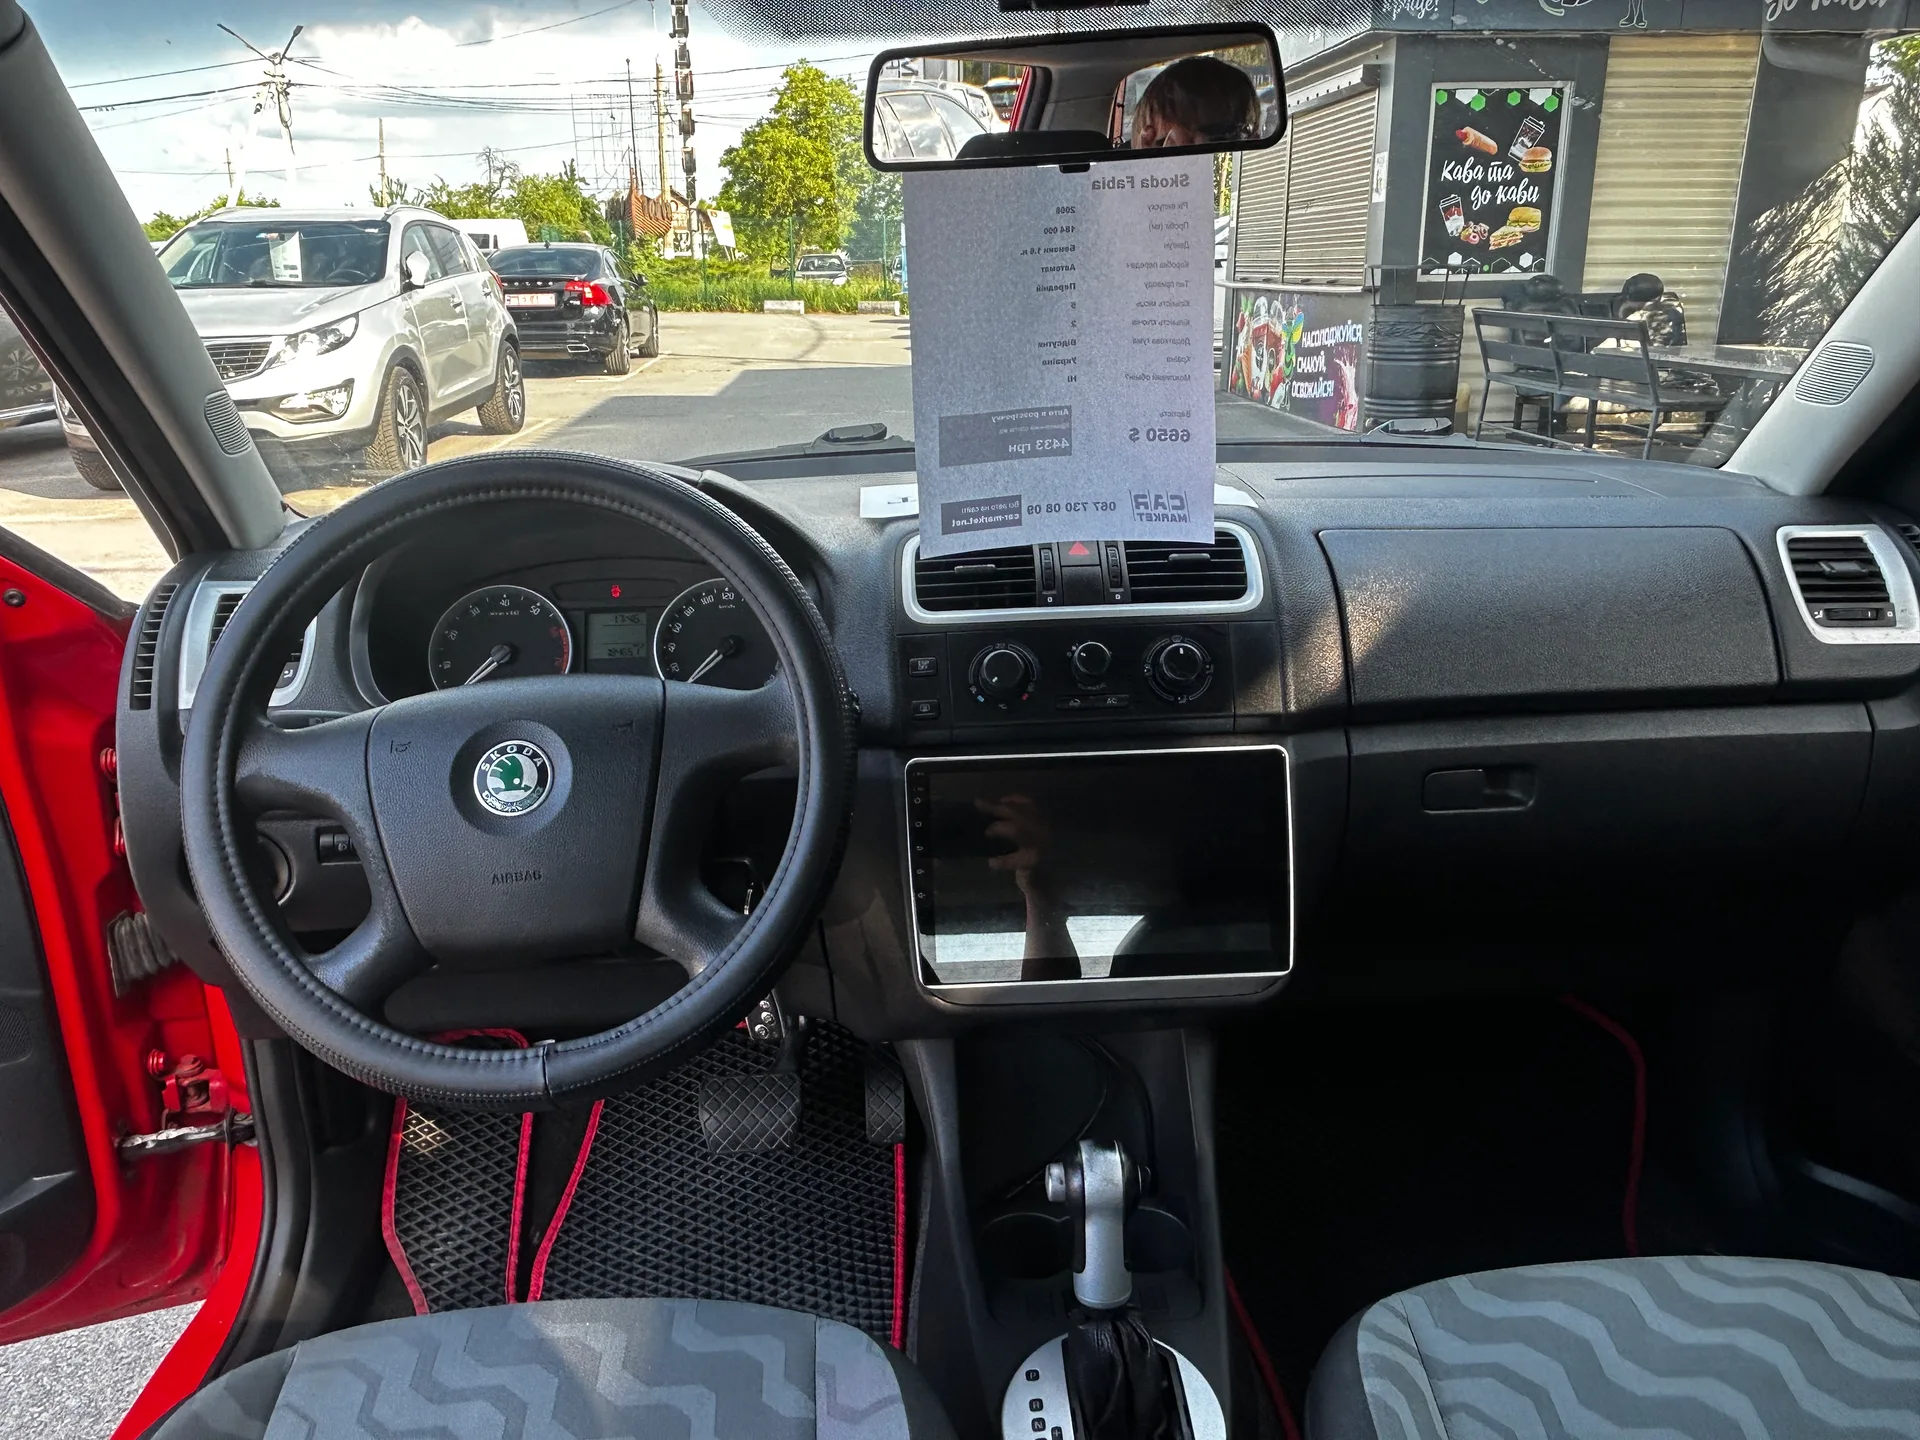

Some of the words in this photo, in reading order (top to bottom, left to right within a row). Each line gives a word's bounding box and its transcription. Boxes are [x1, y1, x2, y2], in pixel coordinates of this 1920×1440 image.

[1441, 156, 1485, 184] Кава
[1488, 161, 1515, 182] та
[1471, 185, 1492, 211] до
[1495, 177, 1540, 205] кави
[1296, 350, 1326, 373] СМАКУЙ,
[499, 599, 510, 607] 40
[721, 592, 735, 600] 120
[529, 605, 541, 616] 50
